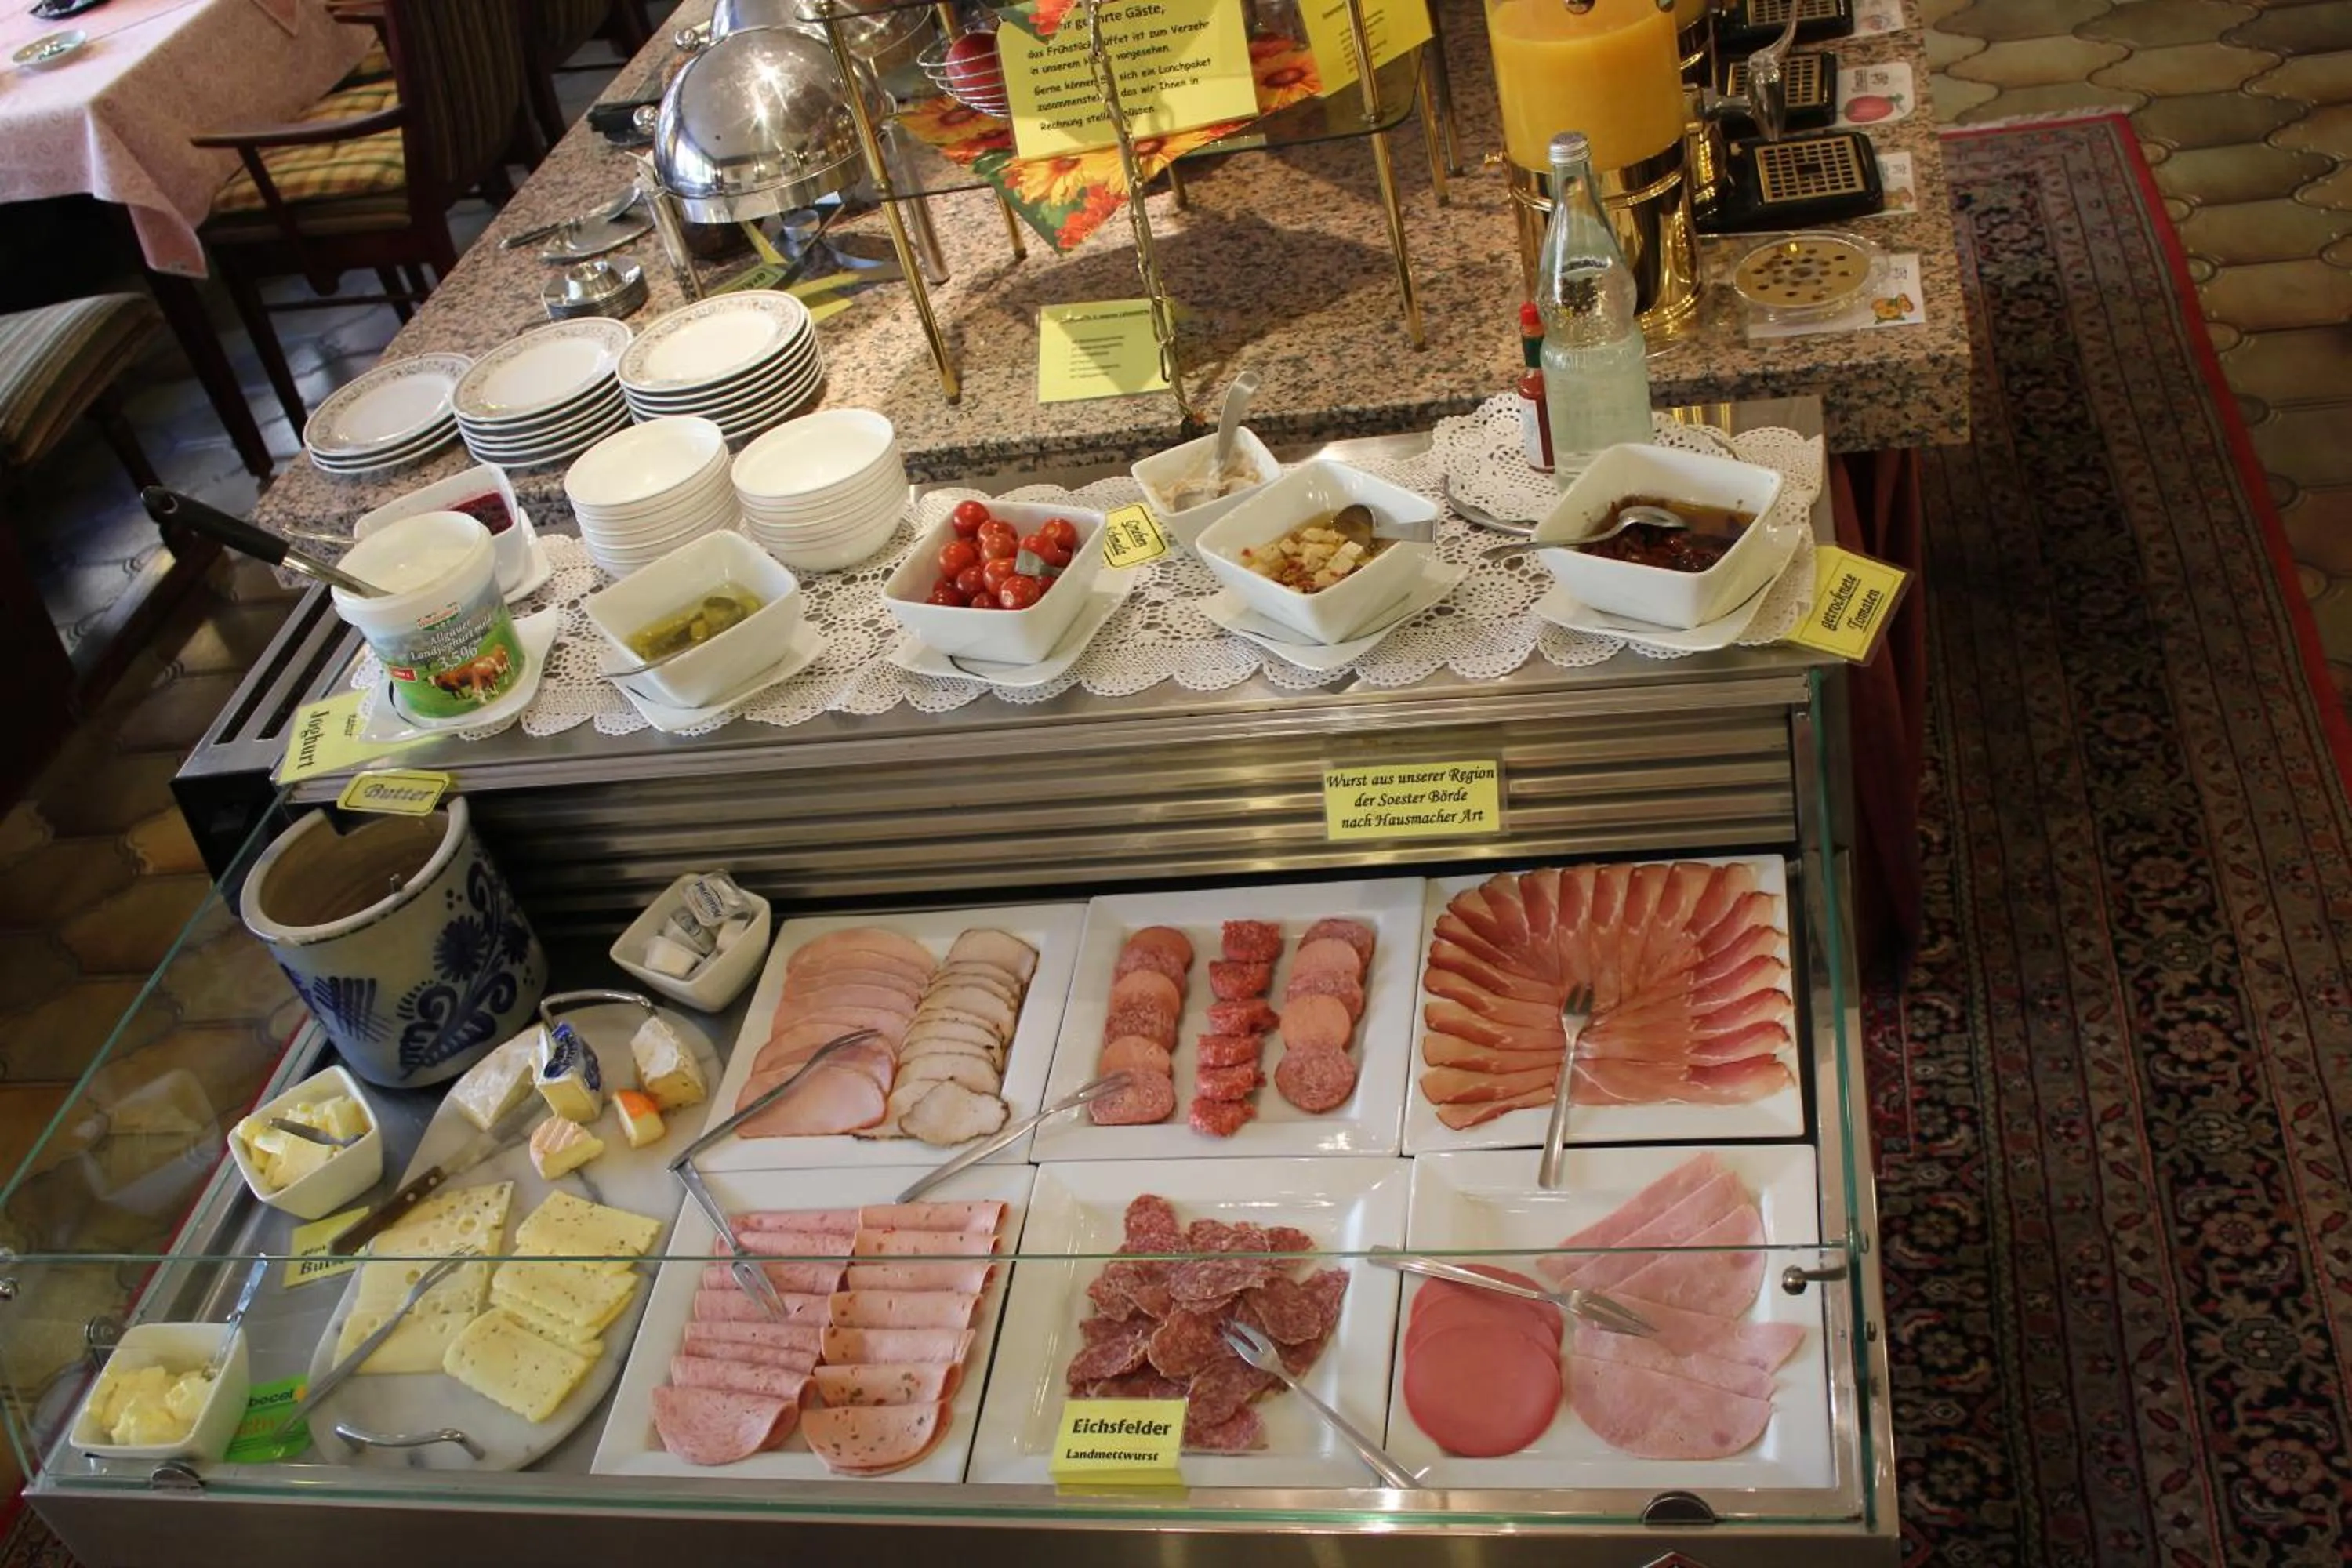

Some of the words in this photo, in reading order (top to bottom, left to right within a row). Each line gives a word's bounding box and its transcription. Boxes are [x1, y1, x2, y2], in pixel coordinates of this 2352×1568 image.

[1125, 4, 1166, 19] Gäste,
[1028, 49, 1044, 59] das
[1149, 29, 1167, 38] zum
[1171, 20, 1210, 34] Verzehr
[1042, 60, 1081, 74] unserem
[1119, 69, 1138, 81] sich
[1158, 57, 1211, 75] Lunchpaket
[1141, 84, 1156, 94] wir
[1160, 78, 1186, 90] Ihnen
[1190, 77, 1199, 85] in
[1040, 117, 1083, 132] Rechnung
[1846, 589, 1880, 630] Tomaten
[296, 710, 330, 770] Joghurt
[1326, 773, 1367, 787] Wurst
[1371, 775, 1394, 786] aus
[1398, 771, 1446, 784] unserer
[1448, 766, 1494, 786] Region
[1354, 793, 1375, 808] der
[1377, 792, 1425, 807] Soester
[1428, 786, 1468, 803] Börde
[1341, 813, 1372, 829] nach
[1374, 808, 1457, 827] Hausmacher
[1458, 808, 1484, 823] Art
[1072, 1418, 1172, 1436] Eichsfelder
[1065, 1448, 1160, 1461] Landmettwurst
